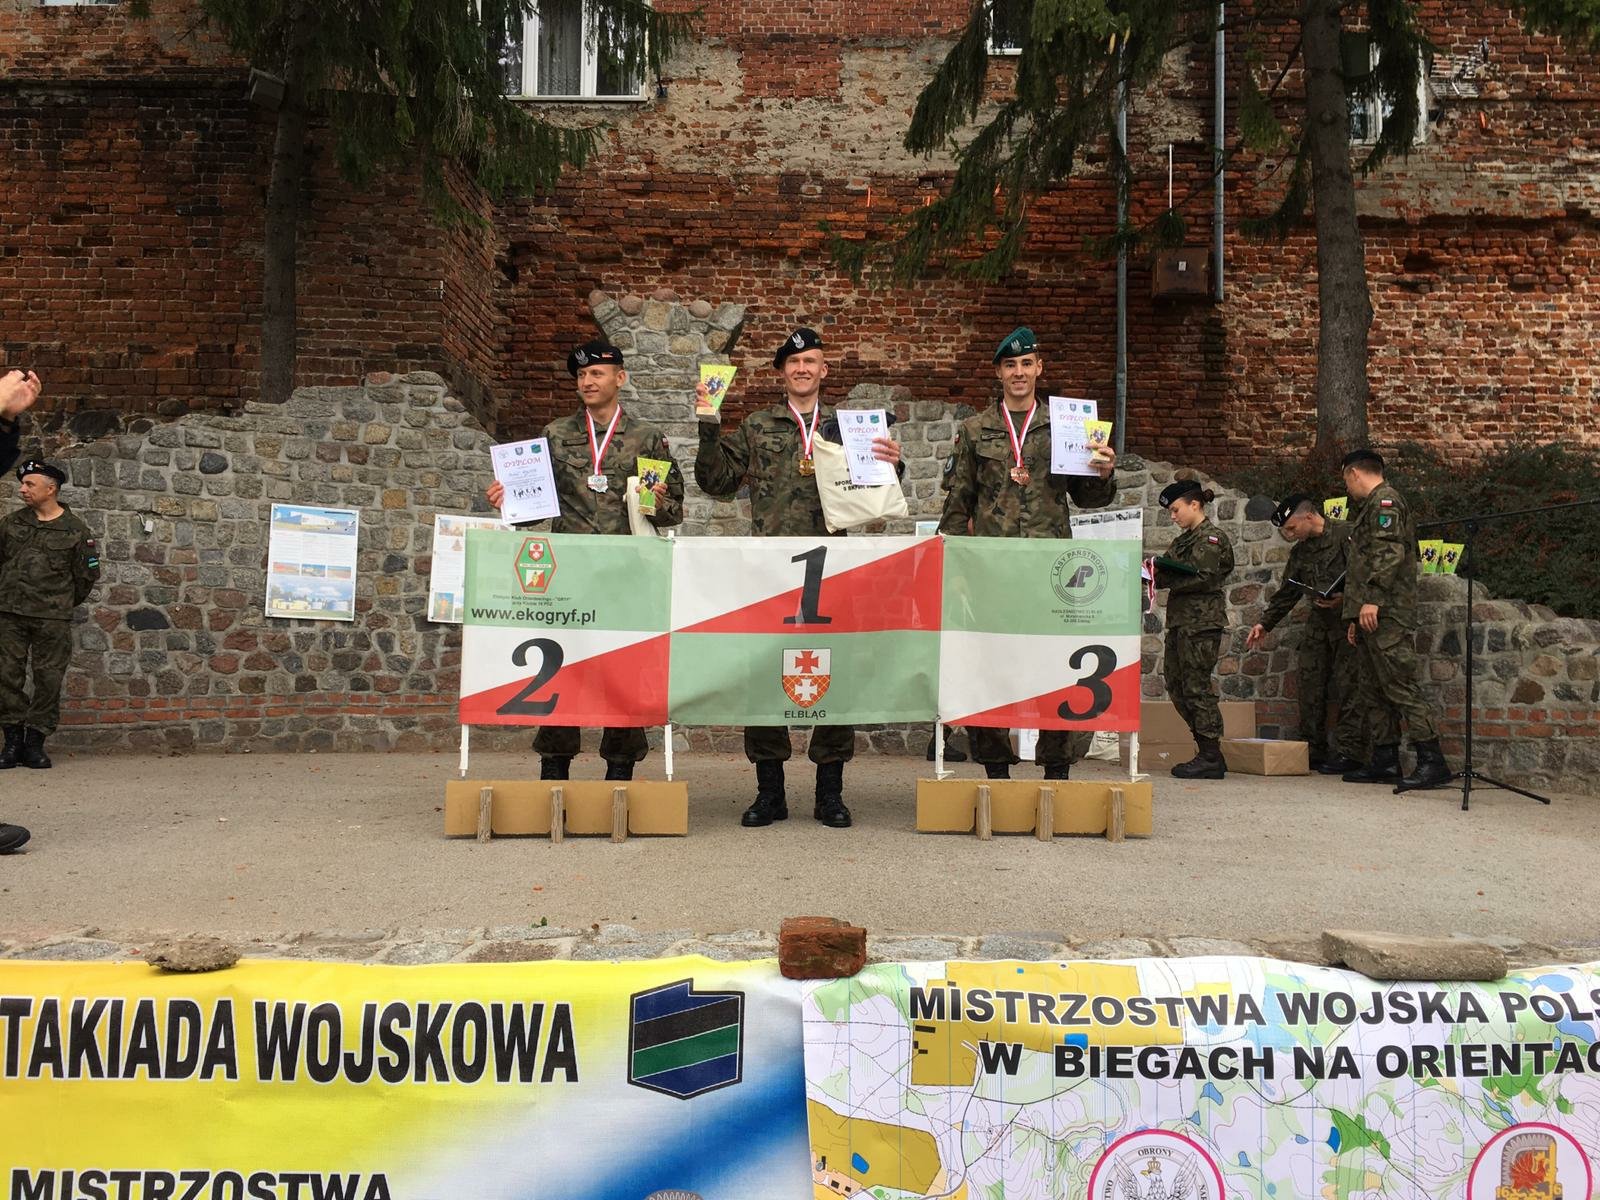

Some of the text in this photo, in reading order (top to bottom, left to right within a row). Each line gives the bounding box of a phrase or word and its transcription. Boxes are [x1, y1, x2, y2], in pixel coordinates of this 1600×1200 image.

[847, 425, 880, 434] DYPLOM
[503, 456, 542, 469] DYPLOM
[1053, 557, 1066, 577] LASY
[783, 545, 832, 625] 1
[471, 608, 596, 626] www.ekogryf.pl
[496, 637, 564, 716] 2
[1057, 644, 1117, 721] 3
[784, 709, 827, 721] ELBLĄG
[909, 986, 1266, 1027] MISTRZOSTWA
[1276, 991, 1490, 1025] WOJSKA
[0, 998, 579, 1084] TAKIADA WOJSKOWA
[978, 1042, 1023, 1076] W
[1054, 1044, 1275, 1081] BIEGACH
[1293, 1046, 1362, 1080] NA
[1137, 1147, 1174, 1157] OBRONY
[11, 1169, 391, 1200] MISTRZOSTWA
